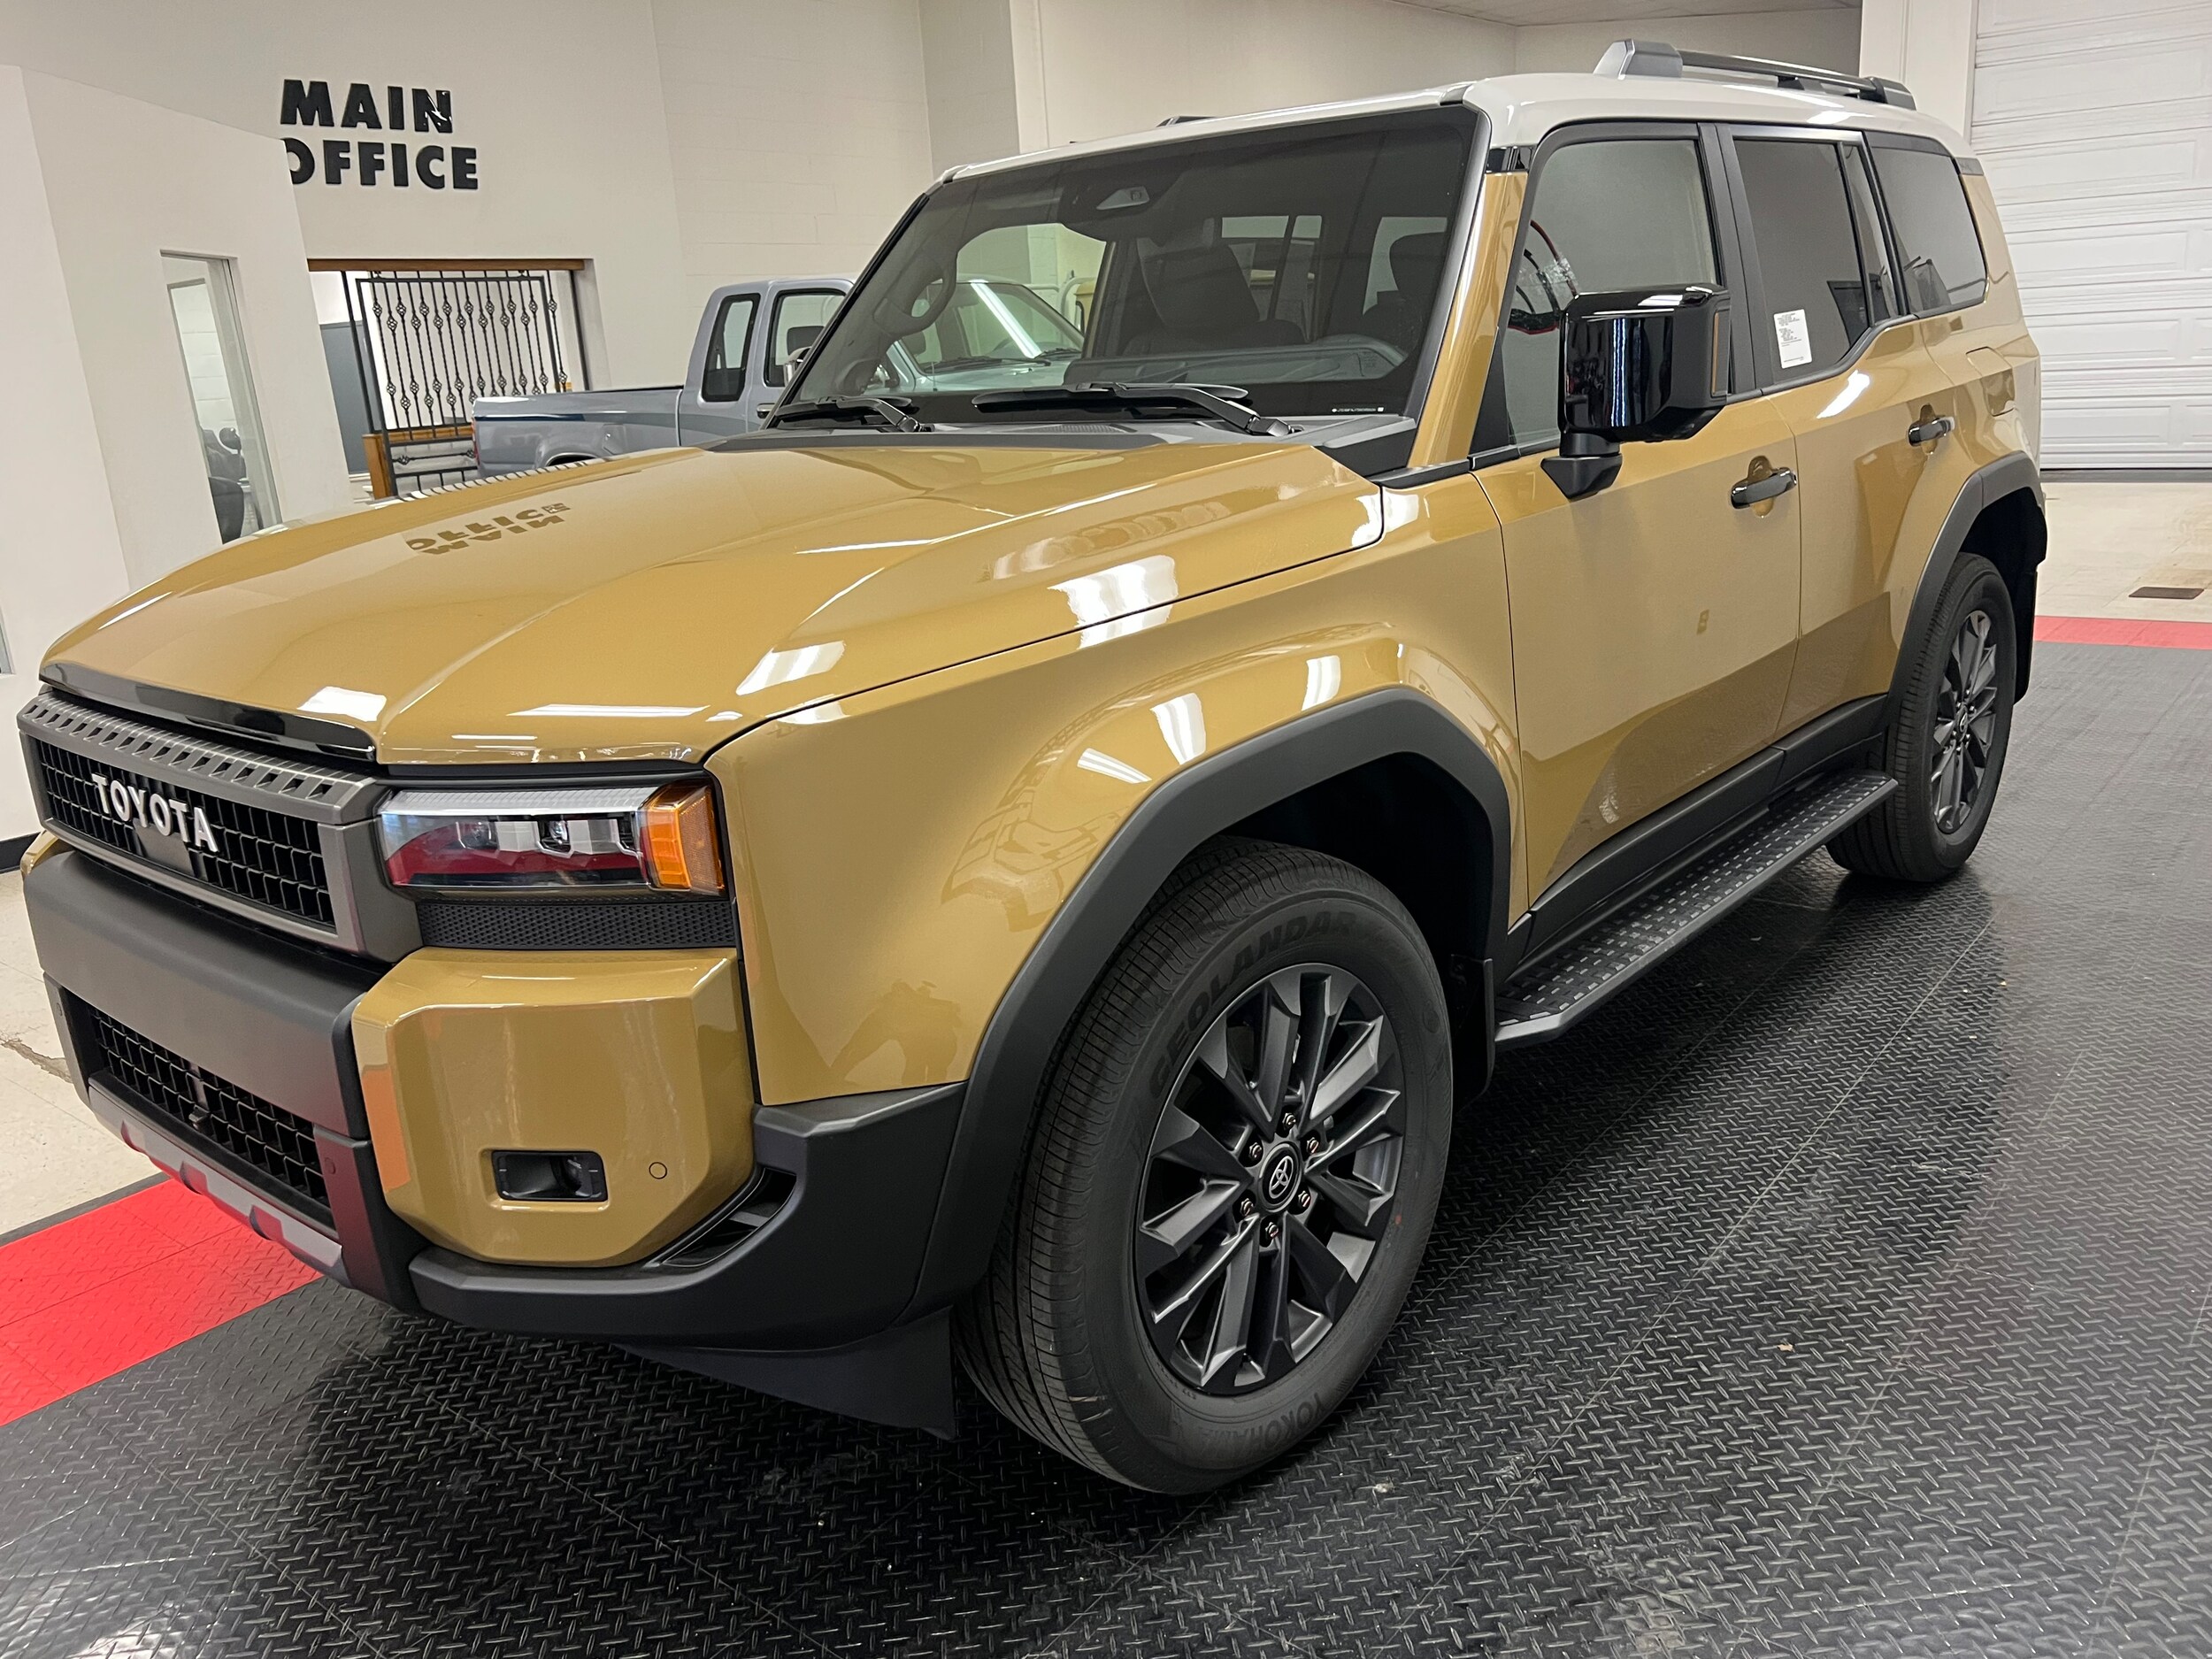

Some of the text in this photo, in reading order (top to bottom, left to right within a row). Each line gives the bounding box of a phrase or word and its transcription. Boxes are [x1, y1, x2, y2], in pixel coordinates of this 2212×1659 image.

[280, 79, 453, 134] MAIN
[281, 137, 478, 189] OFFICE
[91, 773, 219, 852] TOYOTA
